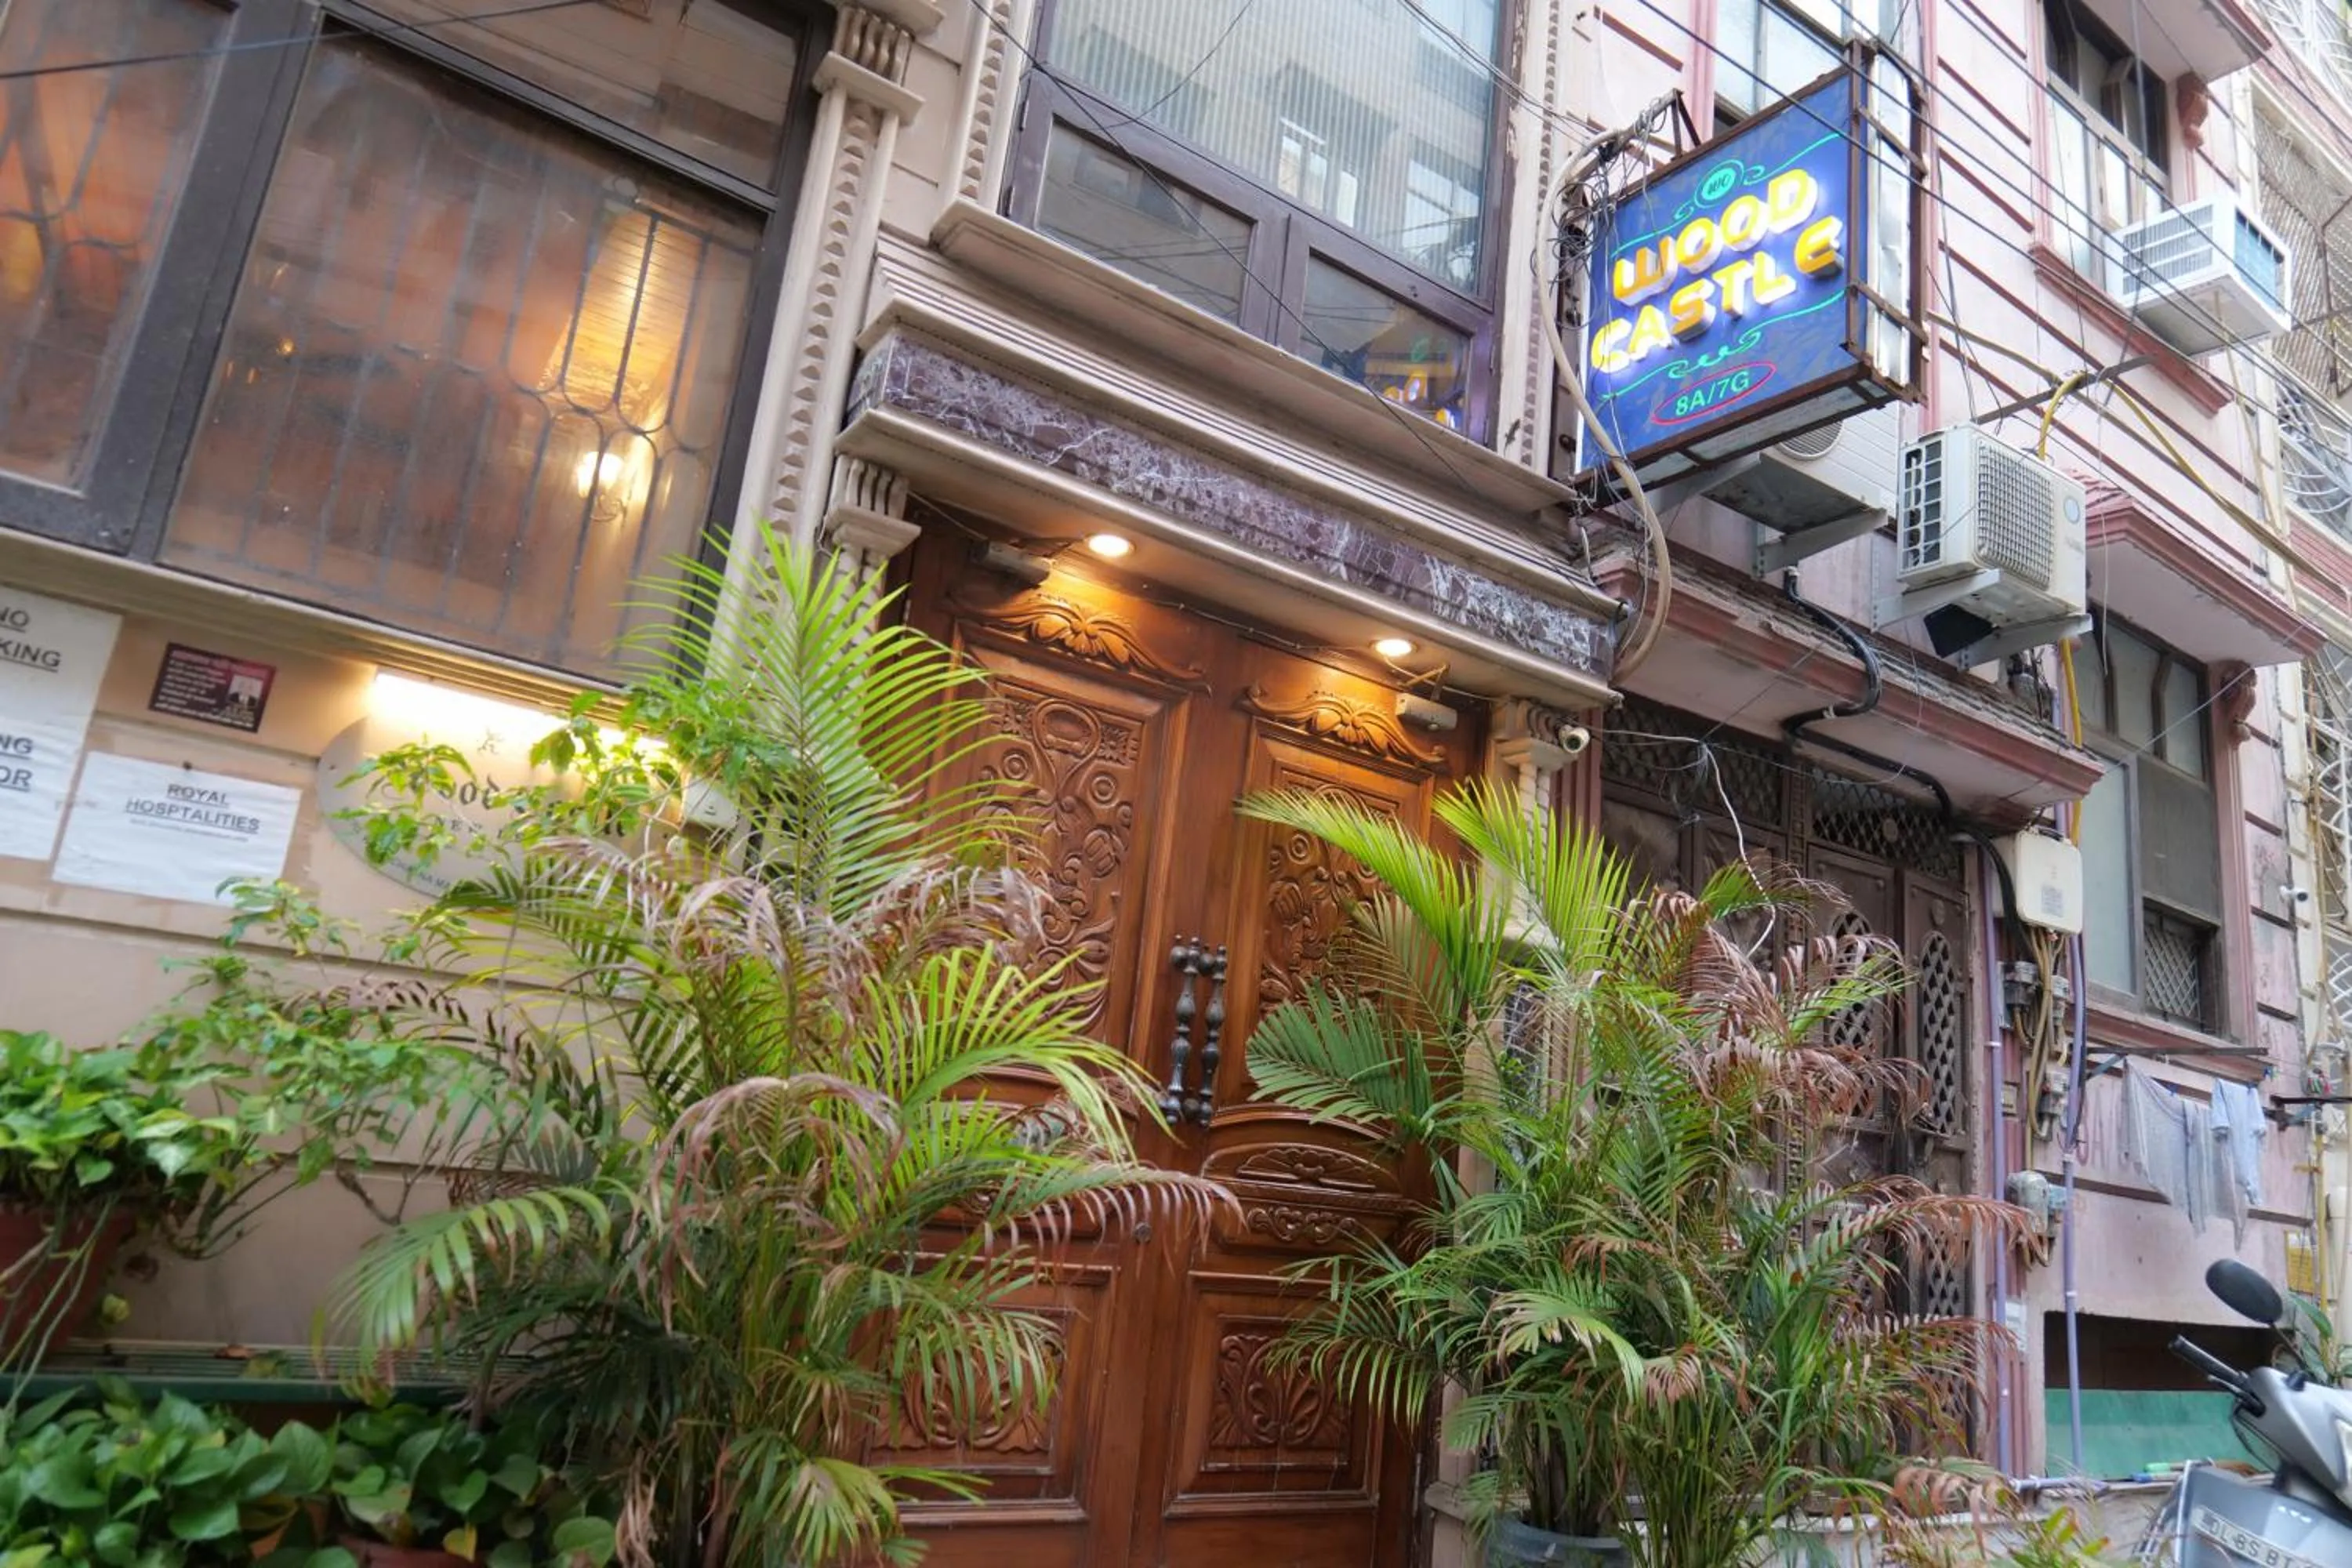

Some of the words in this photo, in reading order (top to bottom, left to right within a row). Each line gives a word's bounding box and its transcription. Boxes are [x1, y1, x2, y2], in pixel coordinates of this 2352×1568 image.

[1613, 169, 1819, 307] WOOD
[1591, 216, 1844, 374] CASTLE
[1675, 370, 1751, 417] 8A/7G
[125, 797, 260, 831] HOSPTALITIES
[167, 784, 230, 806] ROYAL
